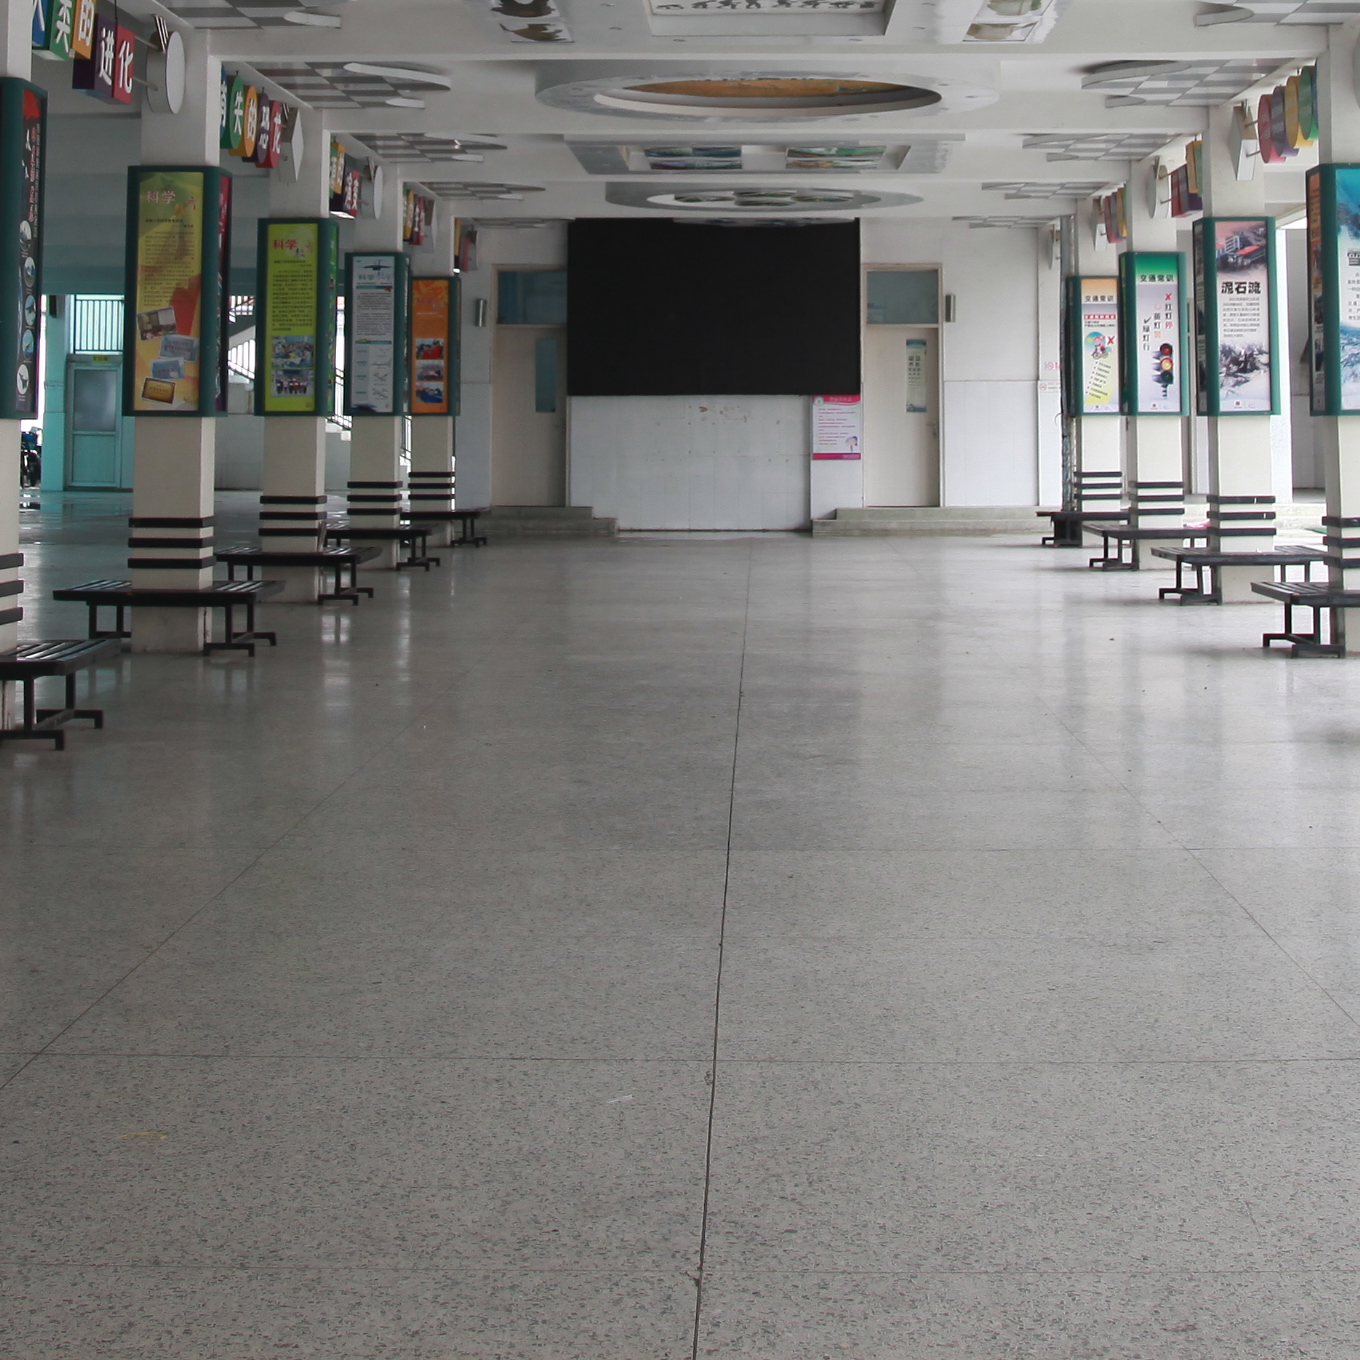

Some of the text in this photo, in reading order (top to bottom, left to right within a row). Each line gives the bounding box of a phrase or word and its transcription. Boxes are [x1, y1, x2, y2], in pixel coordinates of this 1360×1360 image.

[146, 190, 176, 204] 科学
[1221, 281, 1261, 295] 泥石流
